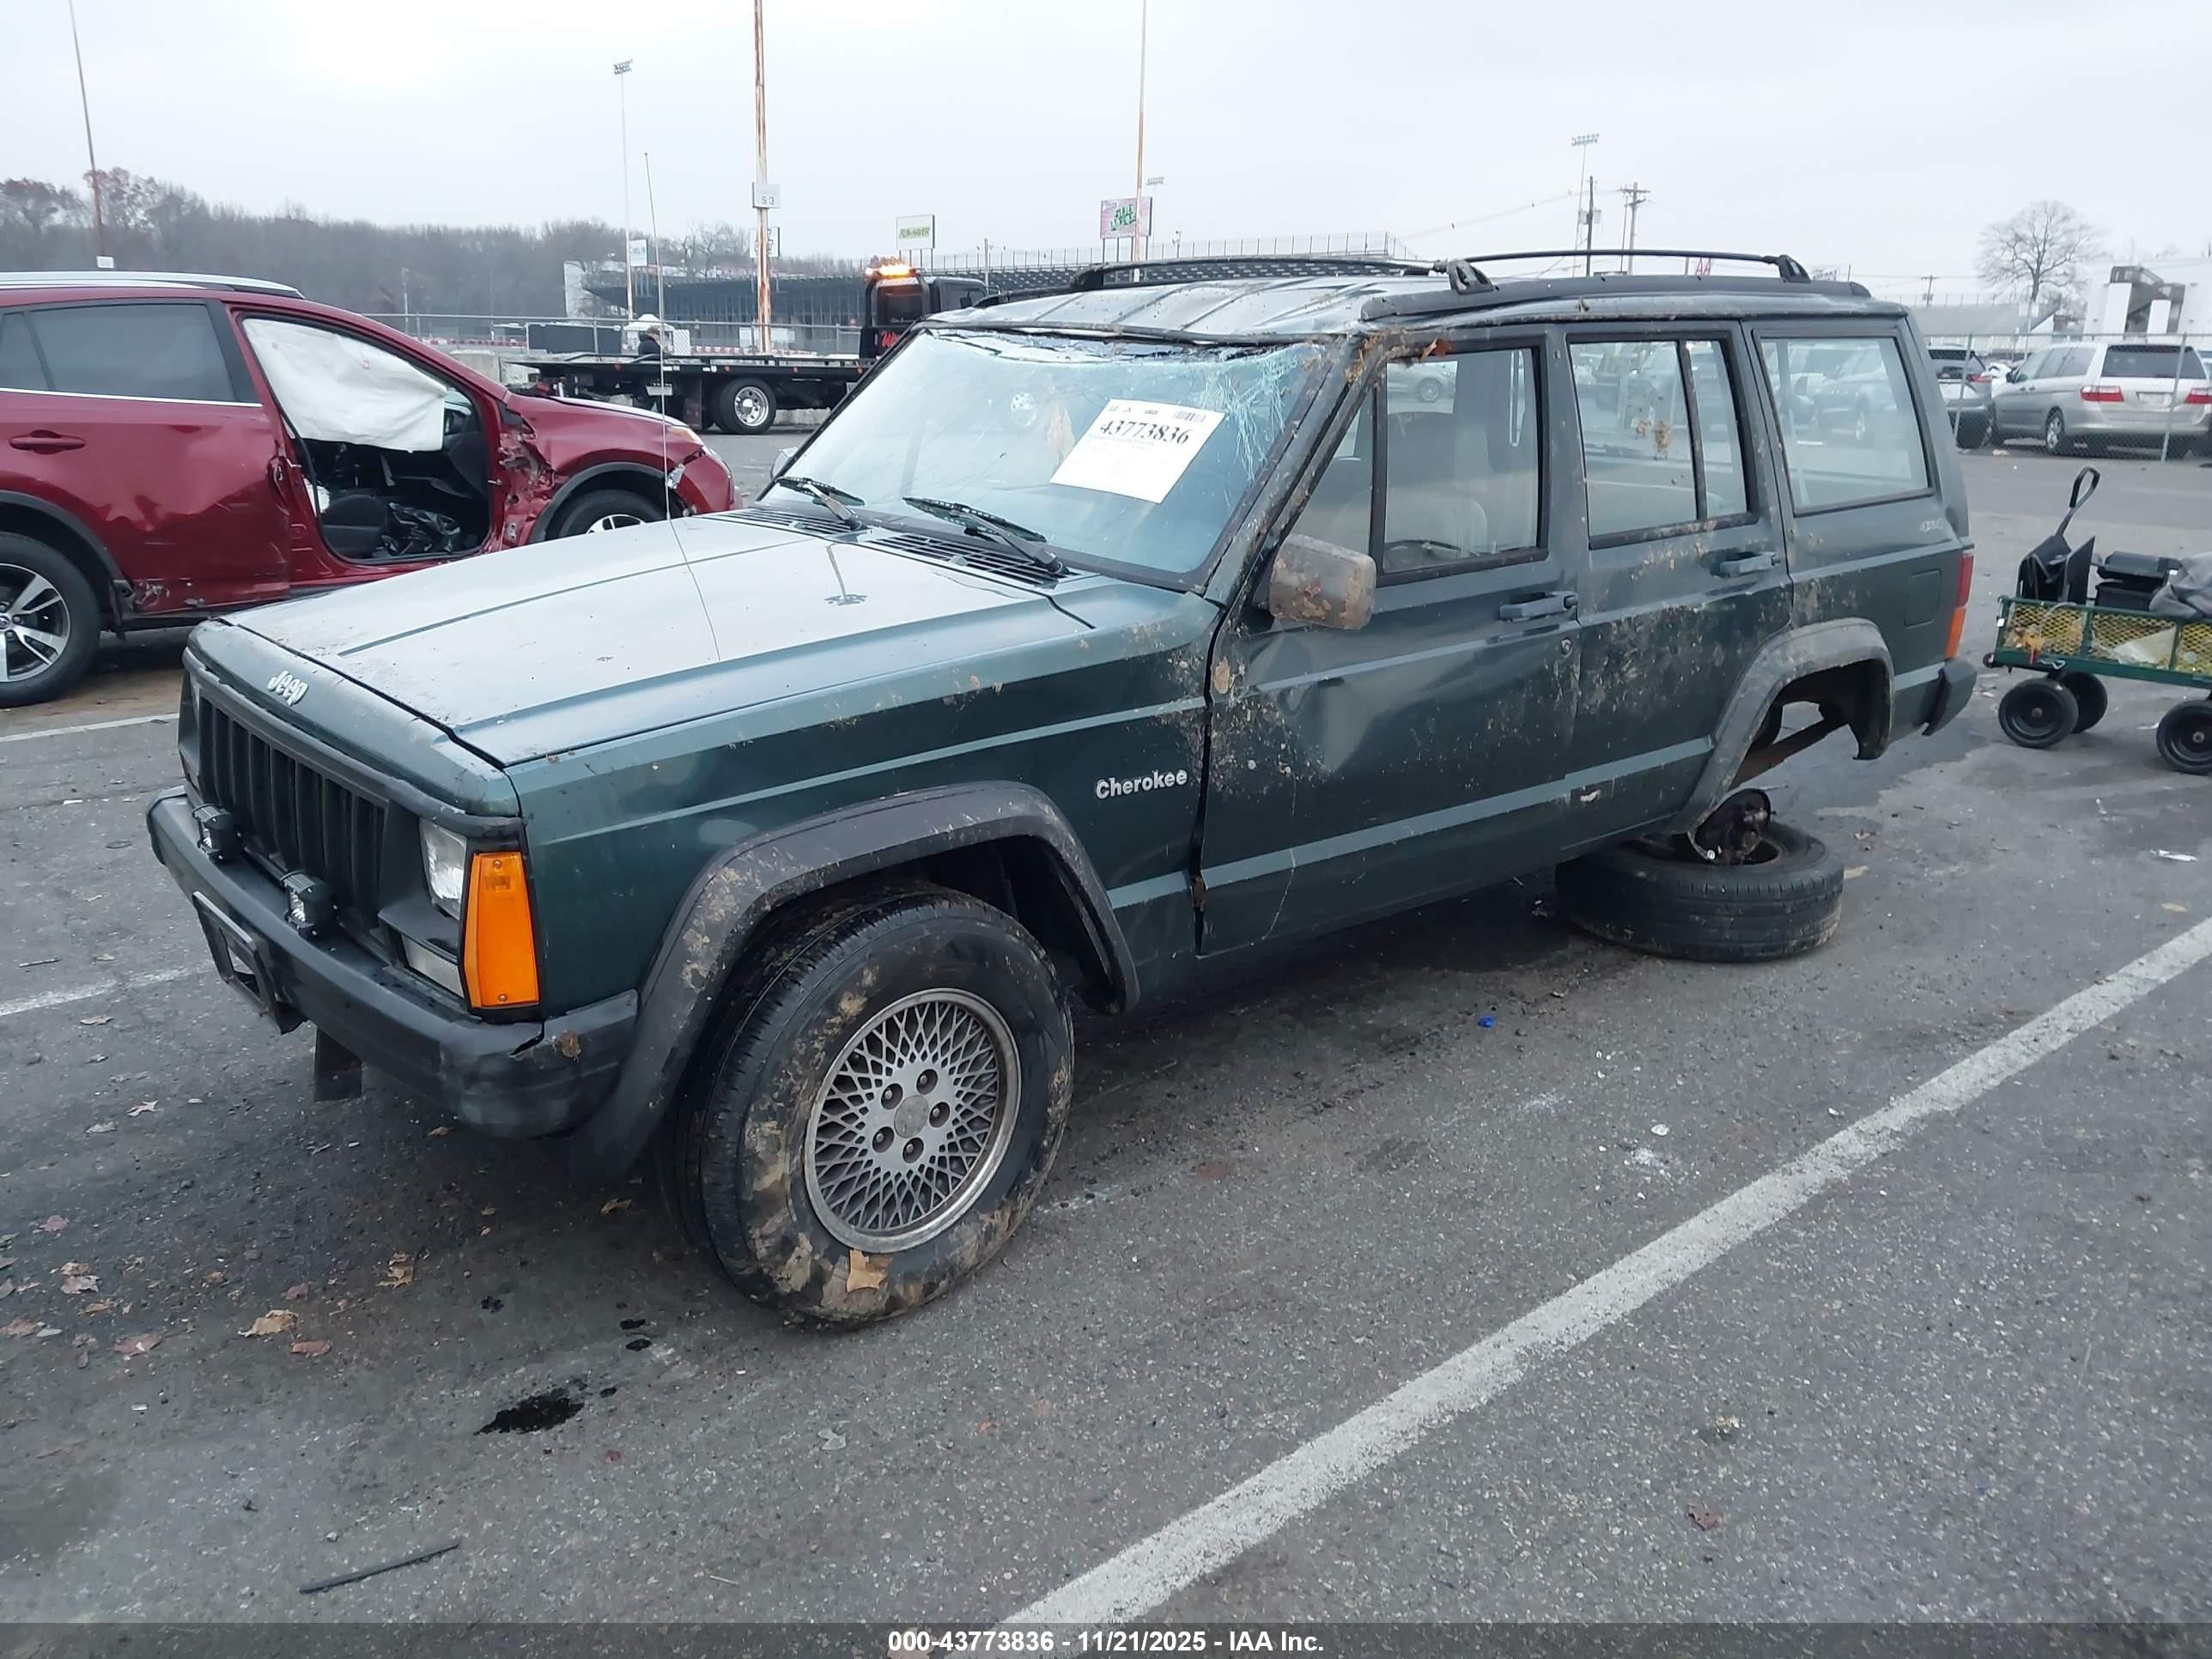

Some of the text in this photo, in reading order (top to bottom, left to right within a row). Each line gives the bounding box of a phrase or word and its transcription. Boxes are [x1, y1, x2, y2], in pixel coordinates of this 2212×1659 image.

[1099, 420, 1194, 445] 43773836
[267, 670, 308, 706] Jeep
[1096, 769, 1188, 799] Cherokee
